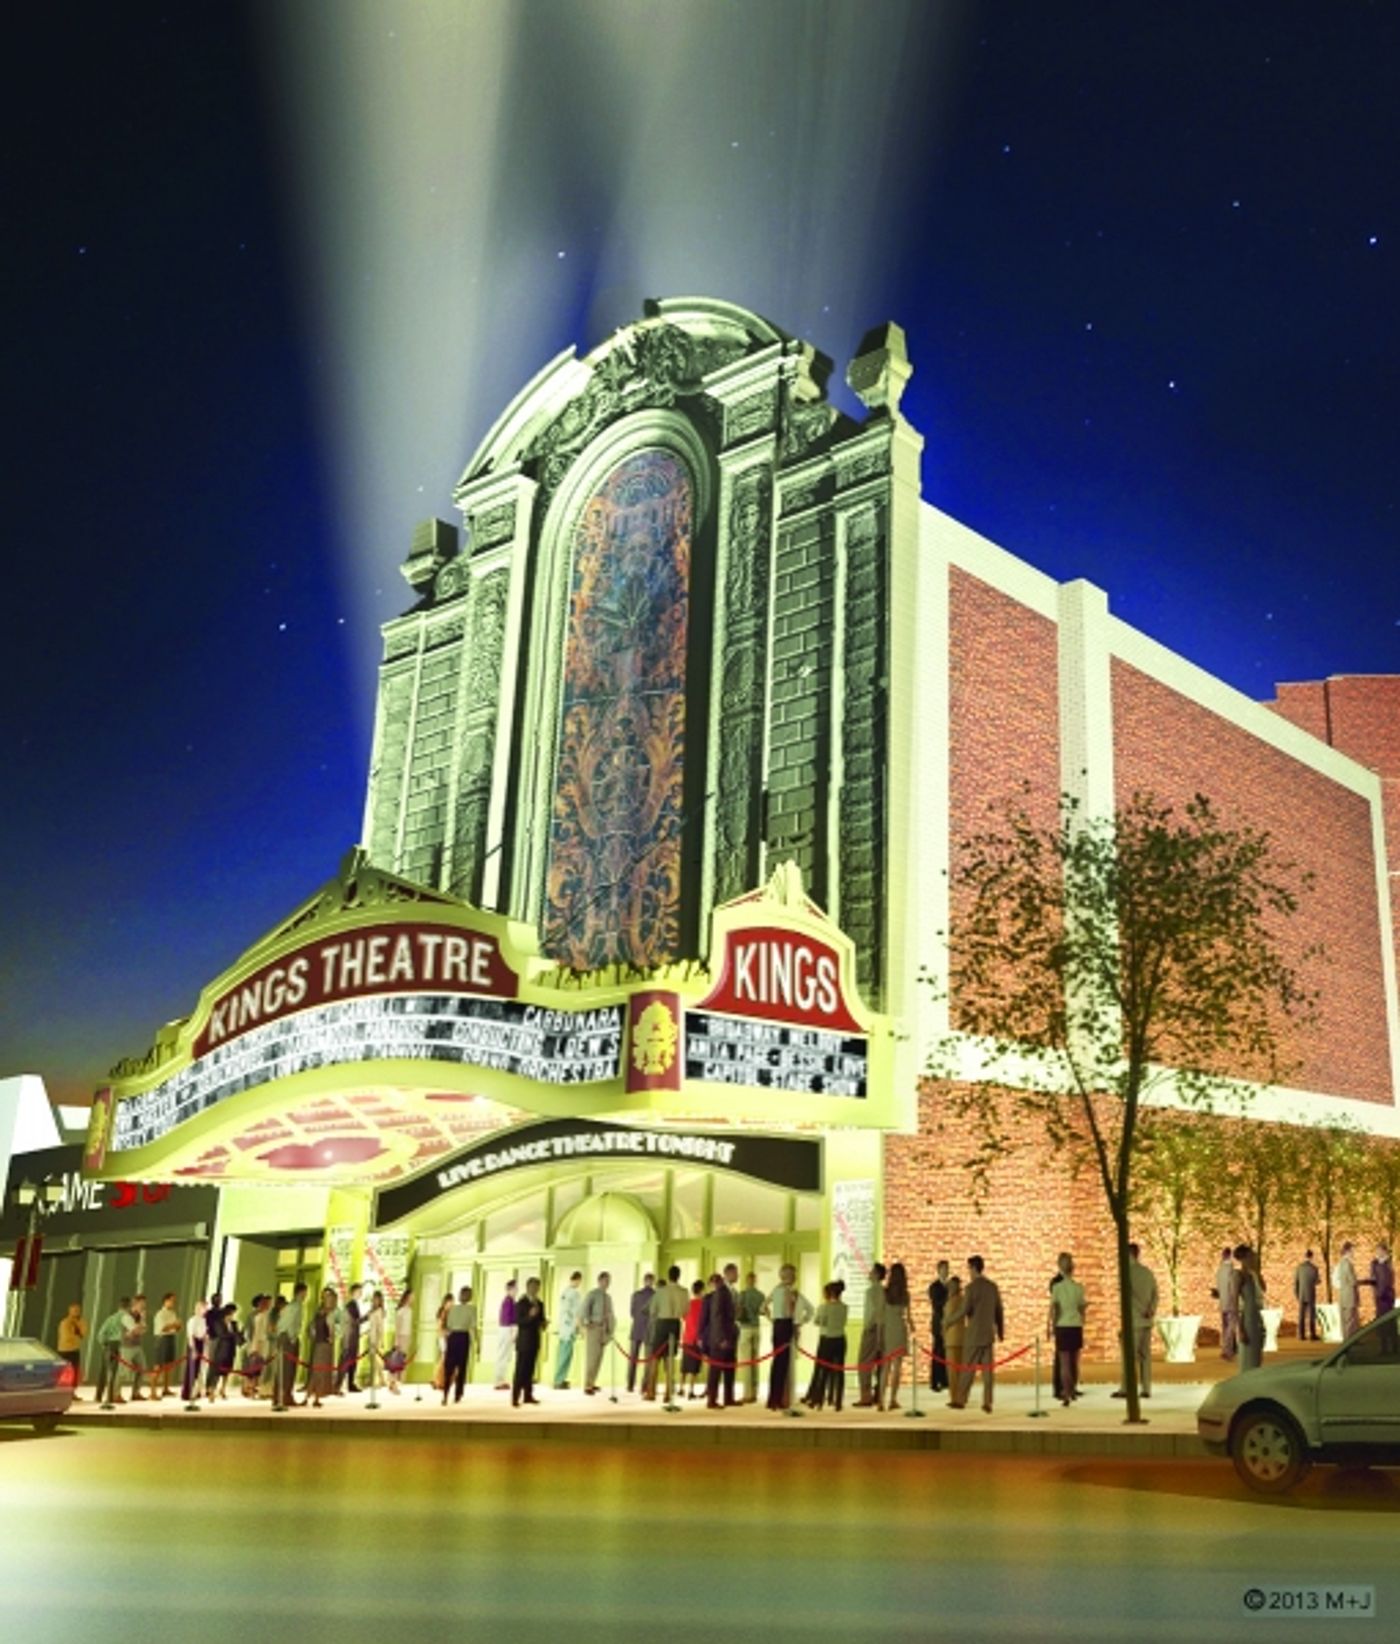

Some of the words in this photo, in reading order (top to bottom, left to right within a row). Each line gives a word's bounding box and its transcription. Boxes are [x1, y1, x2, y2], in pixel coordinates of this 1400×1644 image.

[209, 960, 309, 1044] KINGS
[319, 933, 494, 993] THEATRE
[735, 941, 838, 1013] KINGS
[437, 1159, 483, 1188] LIVE
[483, 1143, 549, 1171] DANCE
[549, 1131, 645, 1155] THEATRE
[647, 1132, 735, 1164] TONIGHT
